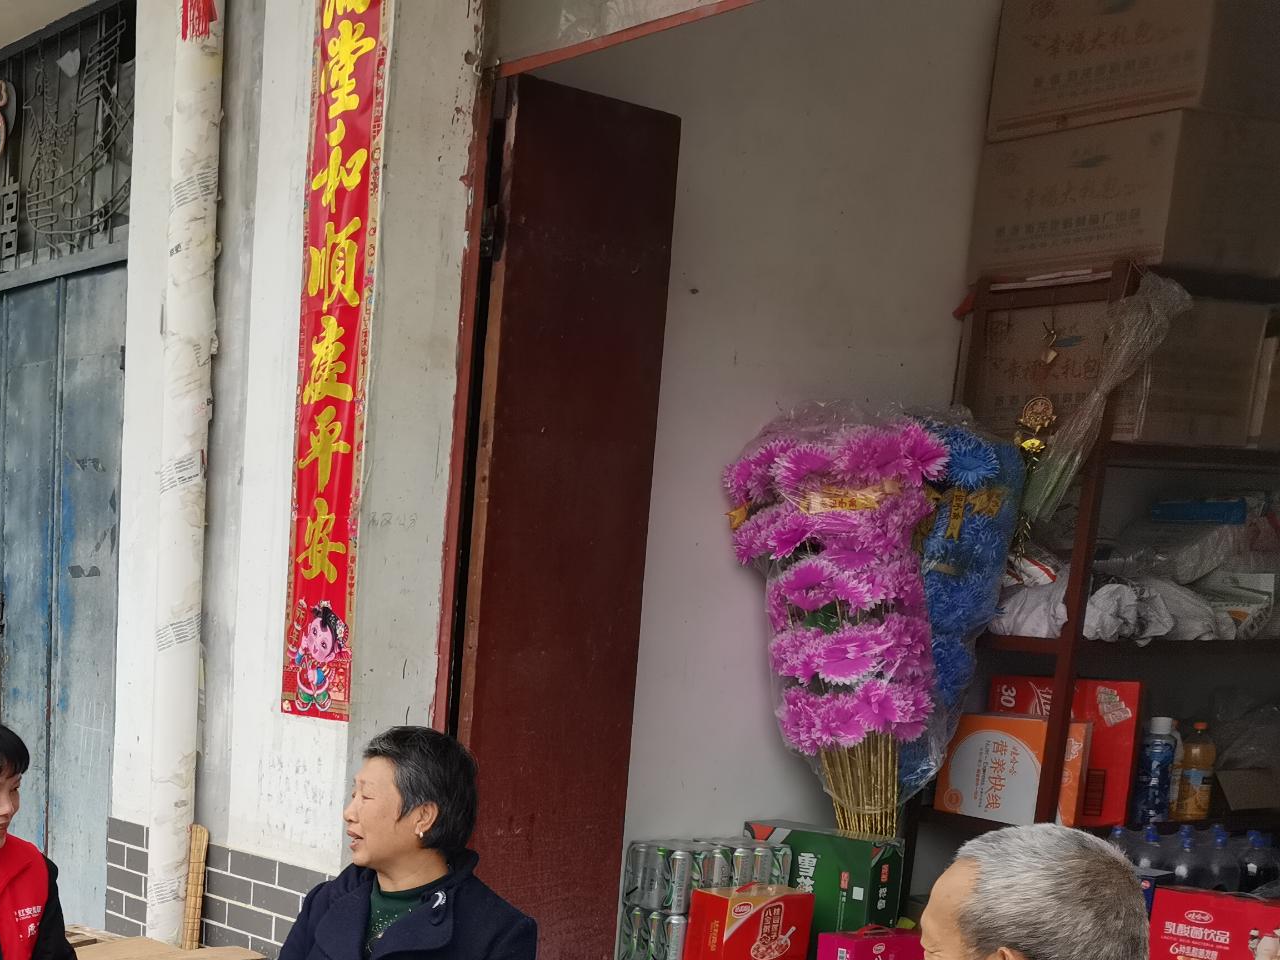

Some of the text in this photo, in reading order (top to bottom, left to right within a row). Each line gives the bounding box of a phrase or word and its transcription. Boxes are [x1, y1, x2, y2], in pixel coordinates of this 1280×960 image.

[1000, 684, 1017, 708] 30
[984, 739, 1009, 810] 营养快线
[1163, 920, 1231, 945] 乳酸菌饮品
